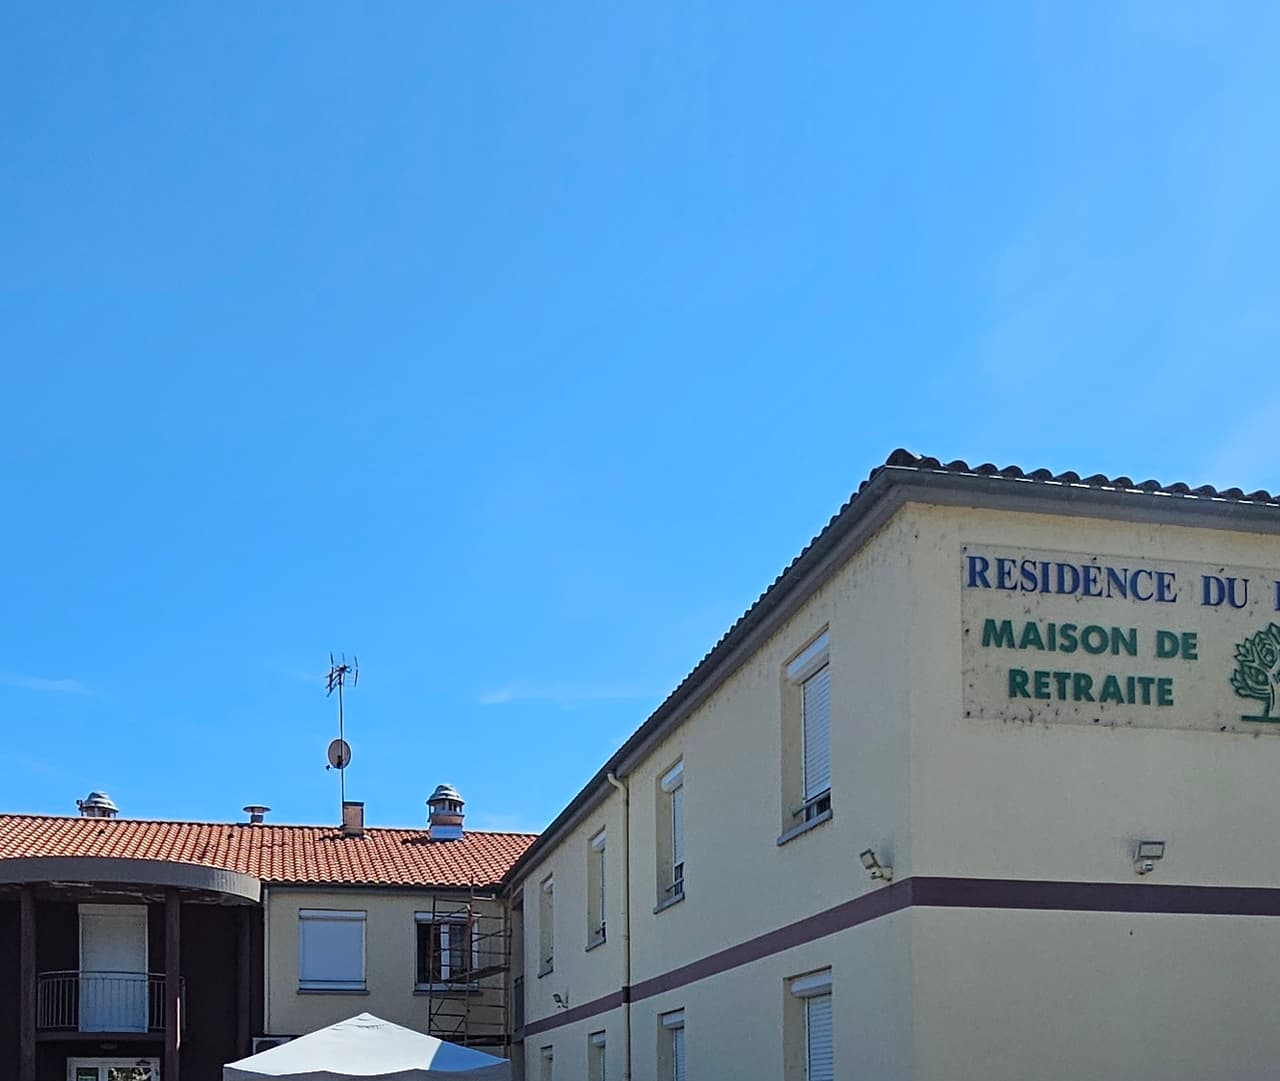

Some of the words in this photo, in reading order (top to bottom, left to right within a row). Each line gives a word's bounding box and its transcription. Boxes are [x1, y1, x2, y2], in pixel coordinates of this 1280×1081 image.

[966, 555, 1177, 603] RESIDENCE
[1201, 575, 1249, 609] DU
[981, 618, 1137, 657] MAISON
[1157, 630, 1198, 660] DE
[1008, 668, 1174, 706] RETRAITE
